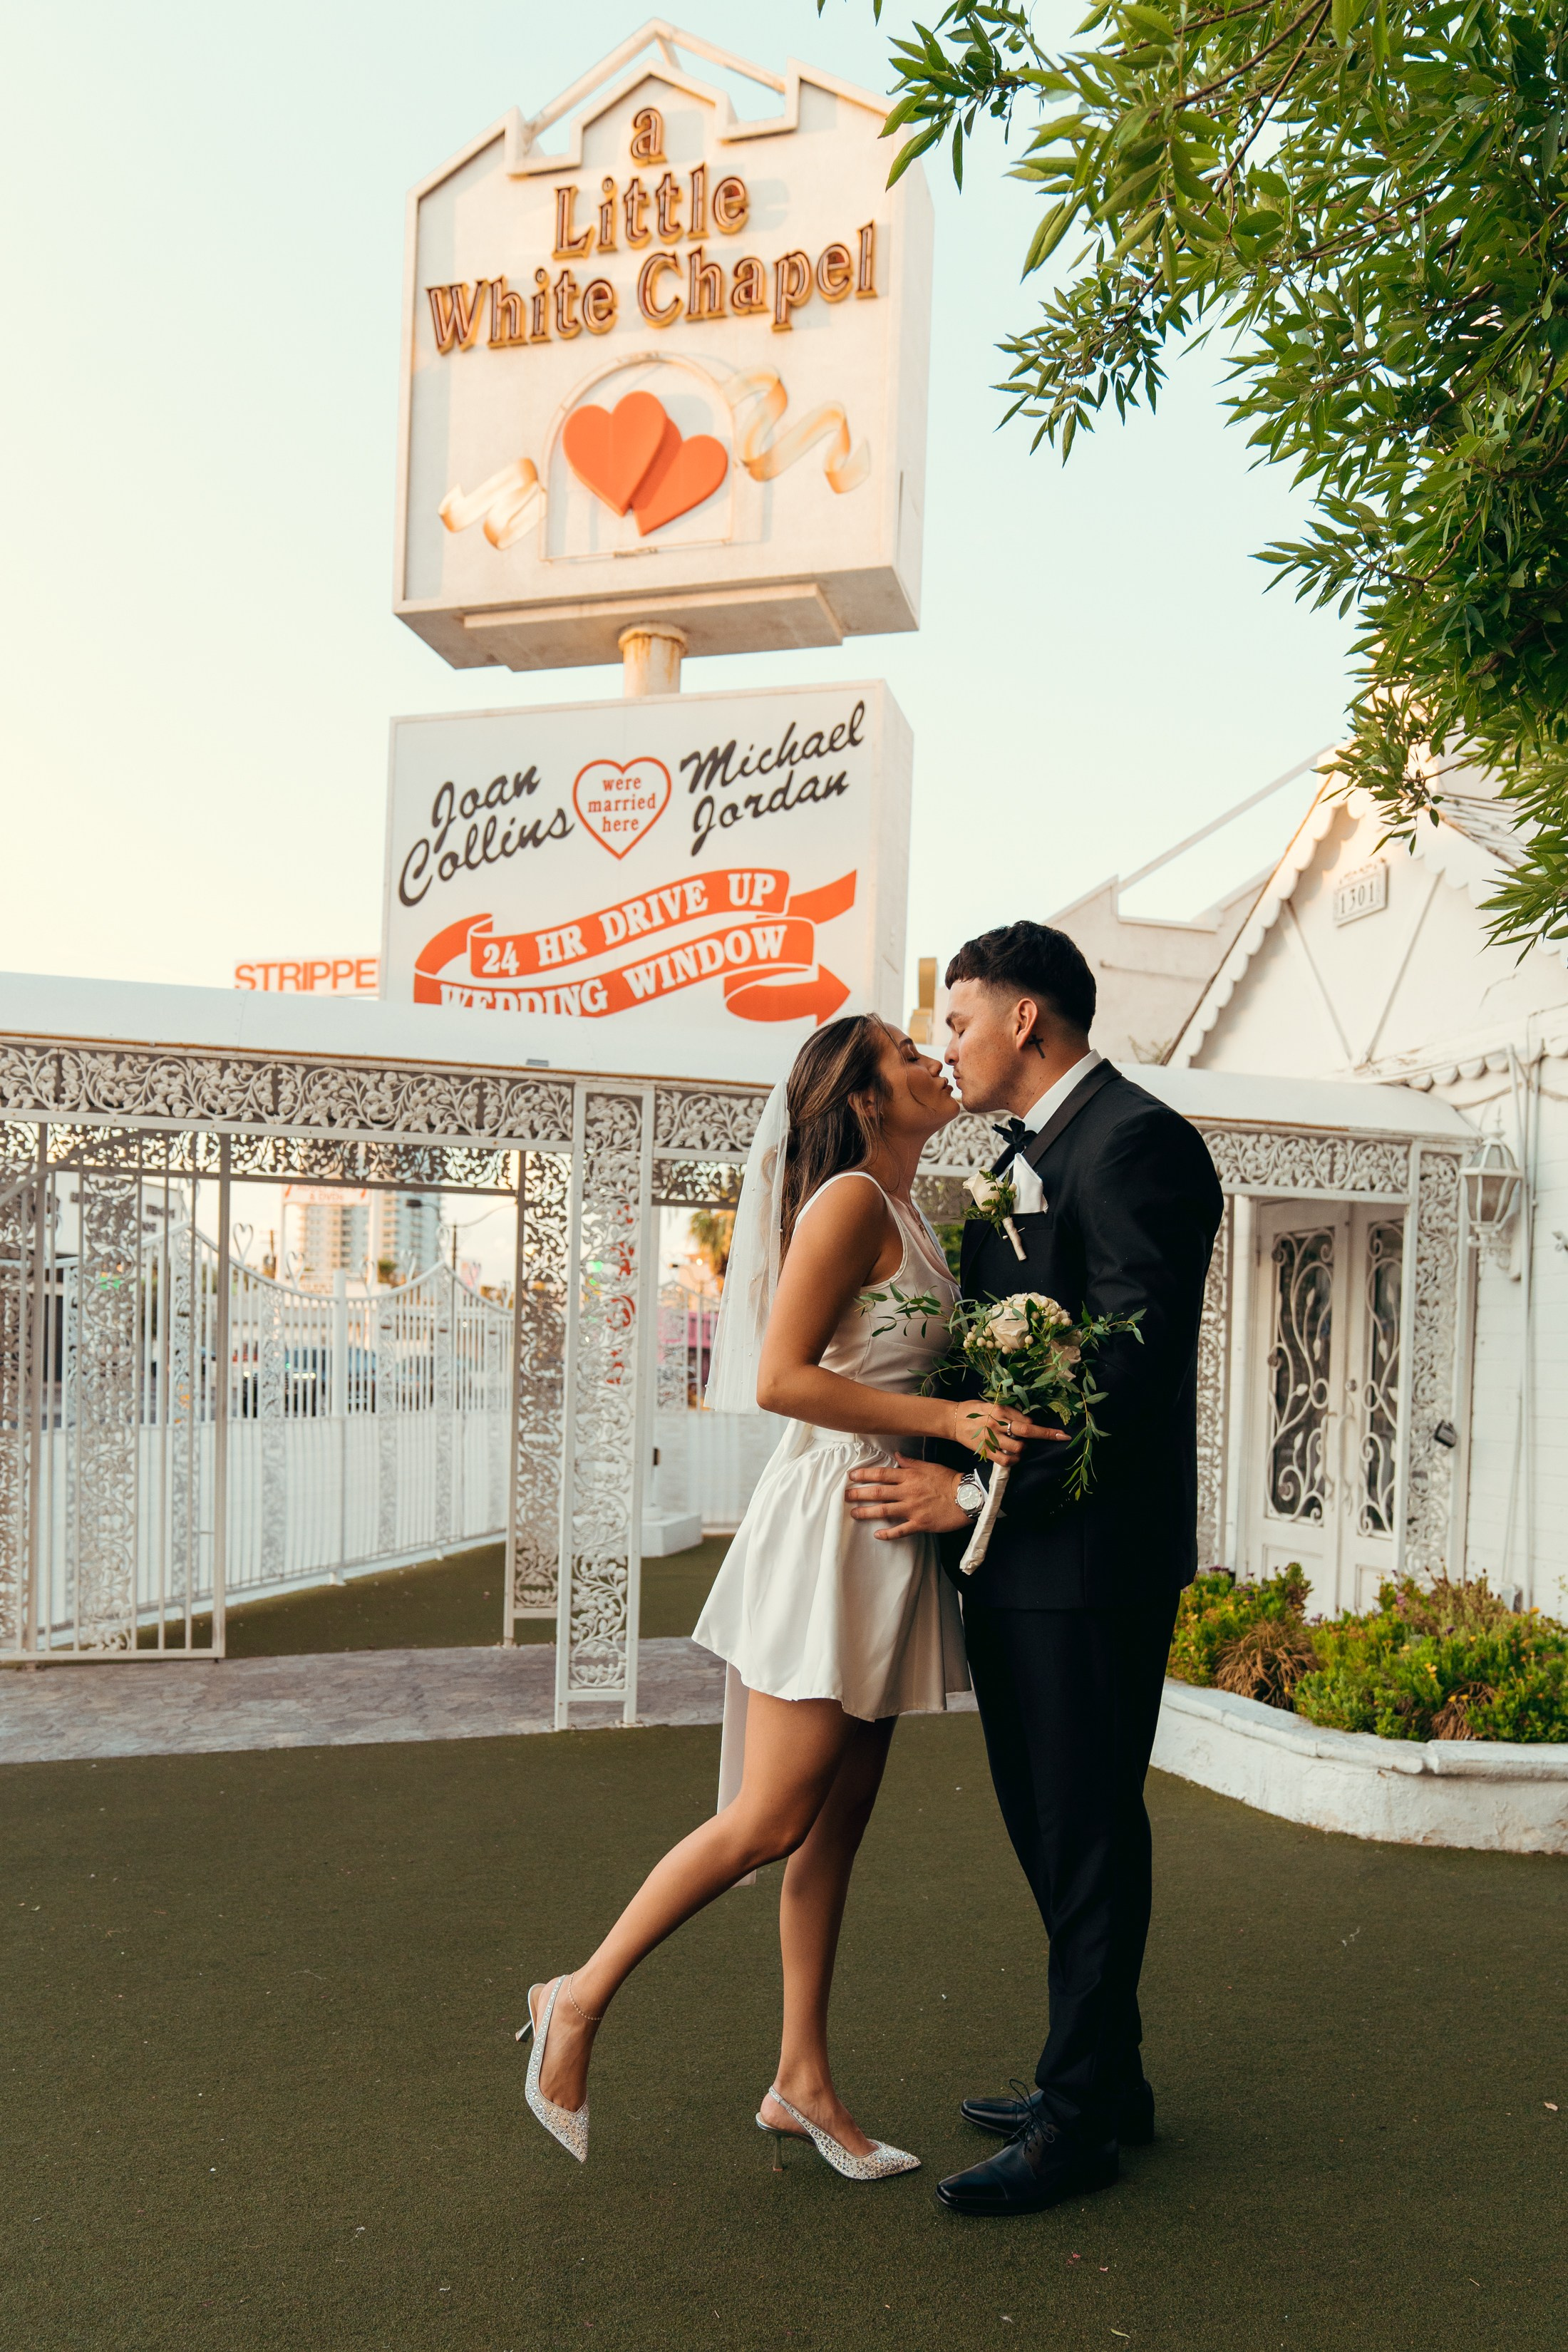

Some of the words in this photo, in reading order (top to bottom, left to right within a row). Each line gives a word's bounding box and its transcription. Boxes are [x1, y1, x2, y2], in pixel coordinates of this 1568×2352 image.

[631, 107, 668, 165] a
[552, 163, 750, 259] Little
[426, 267, 618, 355] White
[637, 220, 877, 332] Chapel
[602, 777, 641, 791] were
[679, 699, 865, 794] Michael
[432, 765, 541, 855] Joan
[588, 793, 656, 813] married
[602, 815, 639, 832] here
[691, 769, 850, 857] Jordan
[398, 807, 575, 907] Collins
[1341, 881, 1373, 914] 1301
[482, 942, 519, 976] 24
[535, 924, 587, 966] HR
[598, 878, 708, 946] DRIVE
[728, 872, 777, 907] UP
[622, 924, 788, 999] WINDOW
